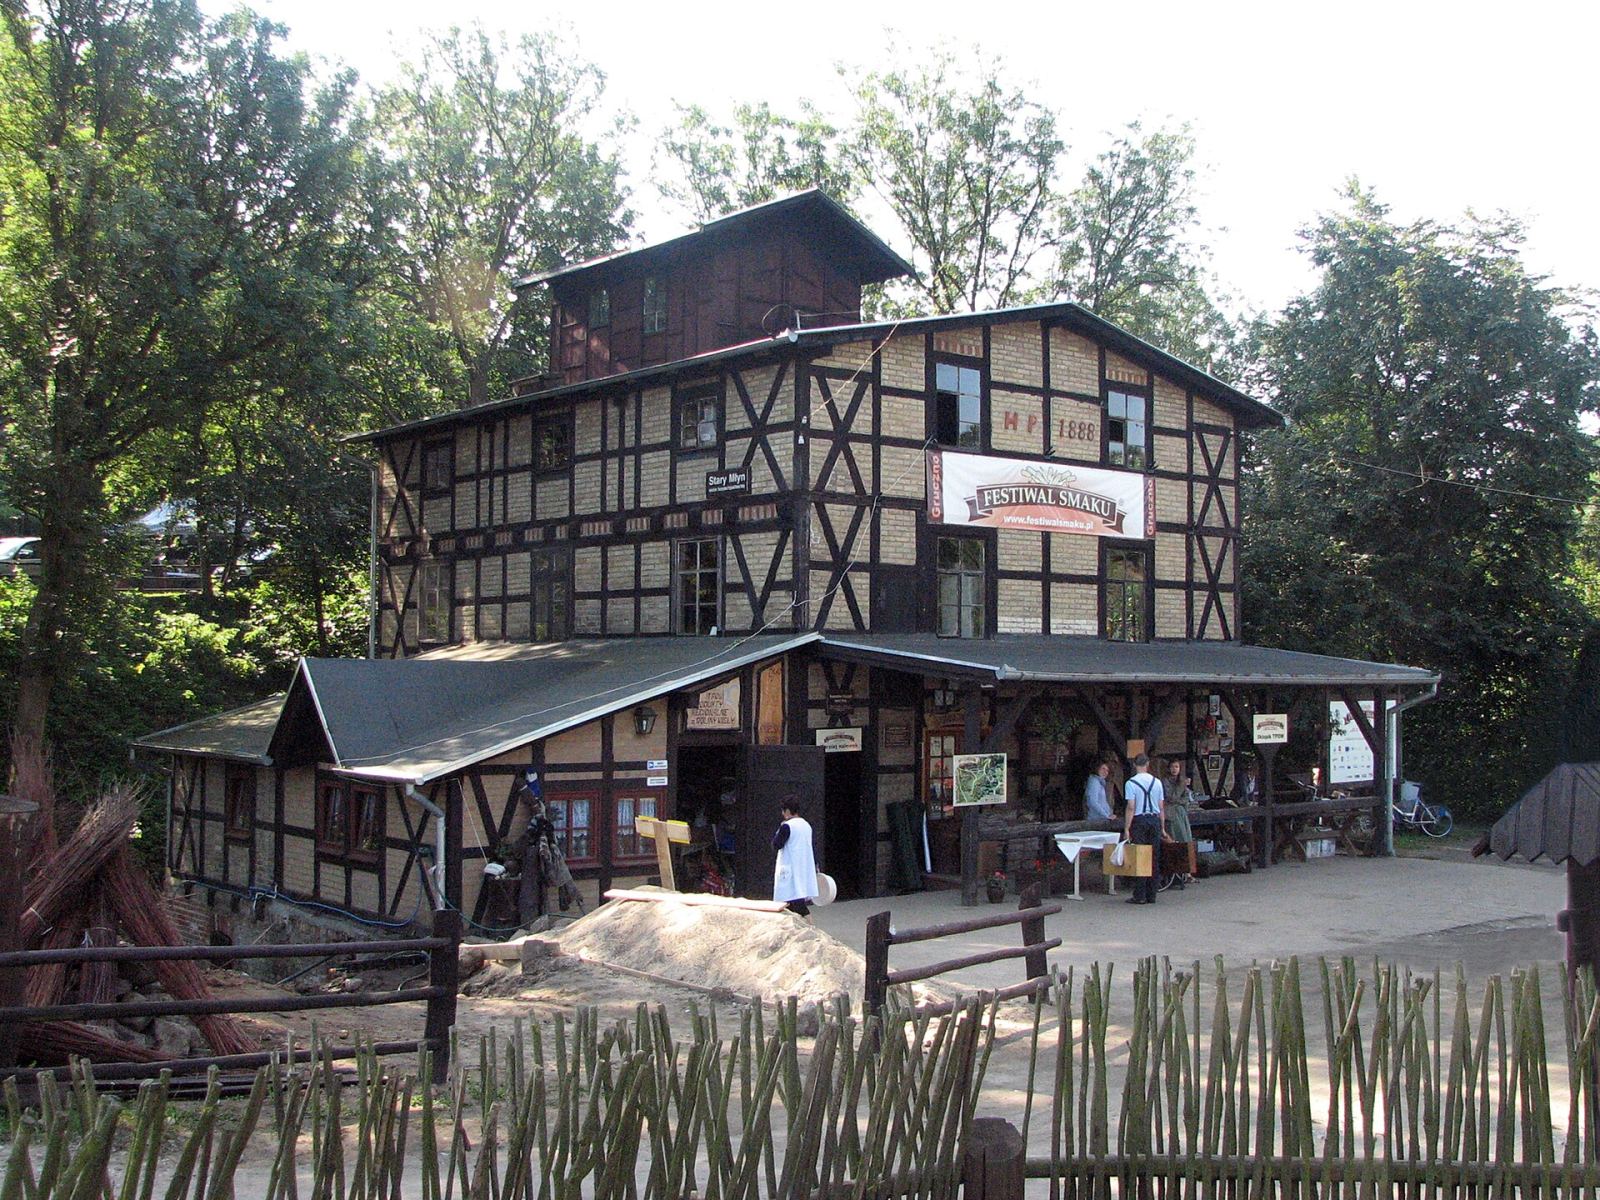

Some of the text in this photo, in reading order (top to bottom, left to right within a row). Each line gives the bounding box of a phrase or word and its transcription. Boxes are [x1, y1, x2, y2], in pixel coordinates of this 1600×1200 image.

[1059, 418, 1095, 442] 1888
[708, 476, 727, 486] Stary
[931, 455, 941, 518] Gruczno
[983, 487, 1112, 517] FESTIWAL SMAKU
[1146, 479, 1154, 536] Gruczno
[1003, 514, 1093, 531] www.festiwalsmaku.pl
